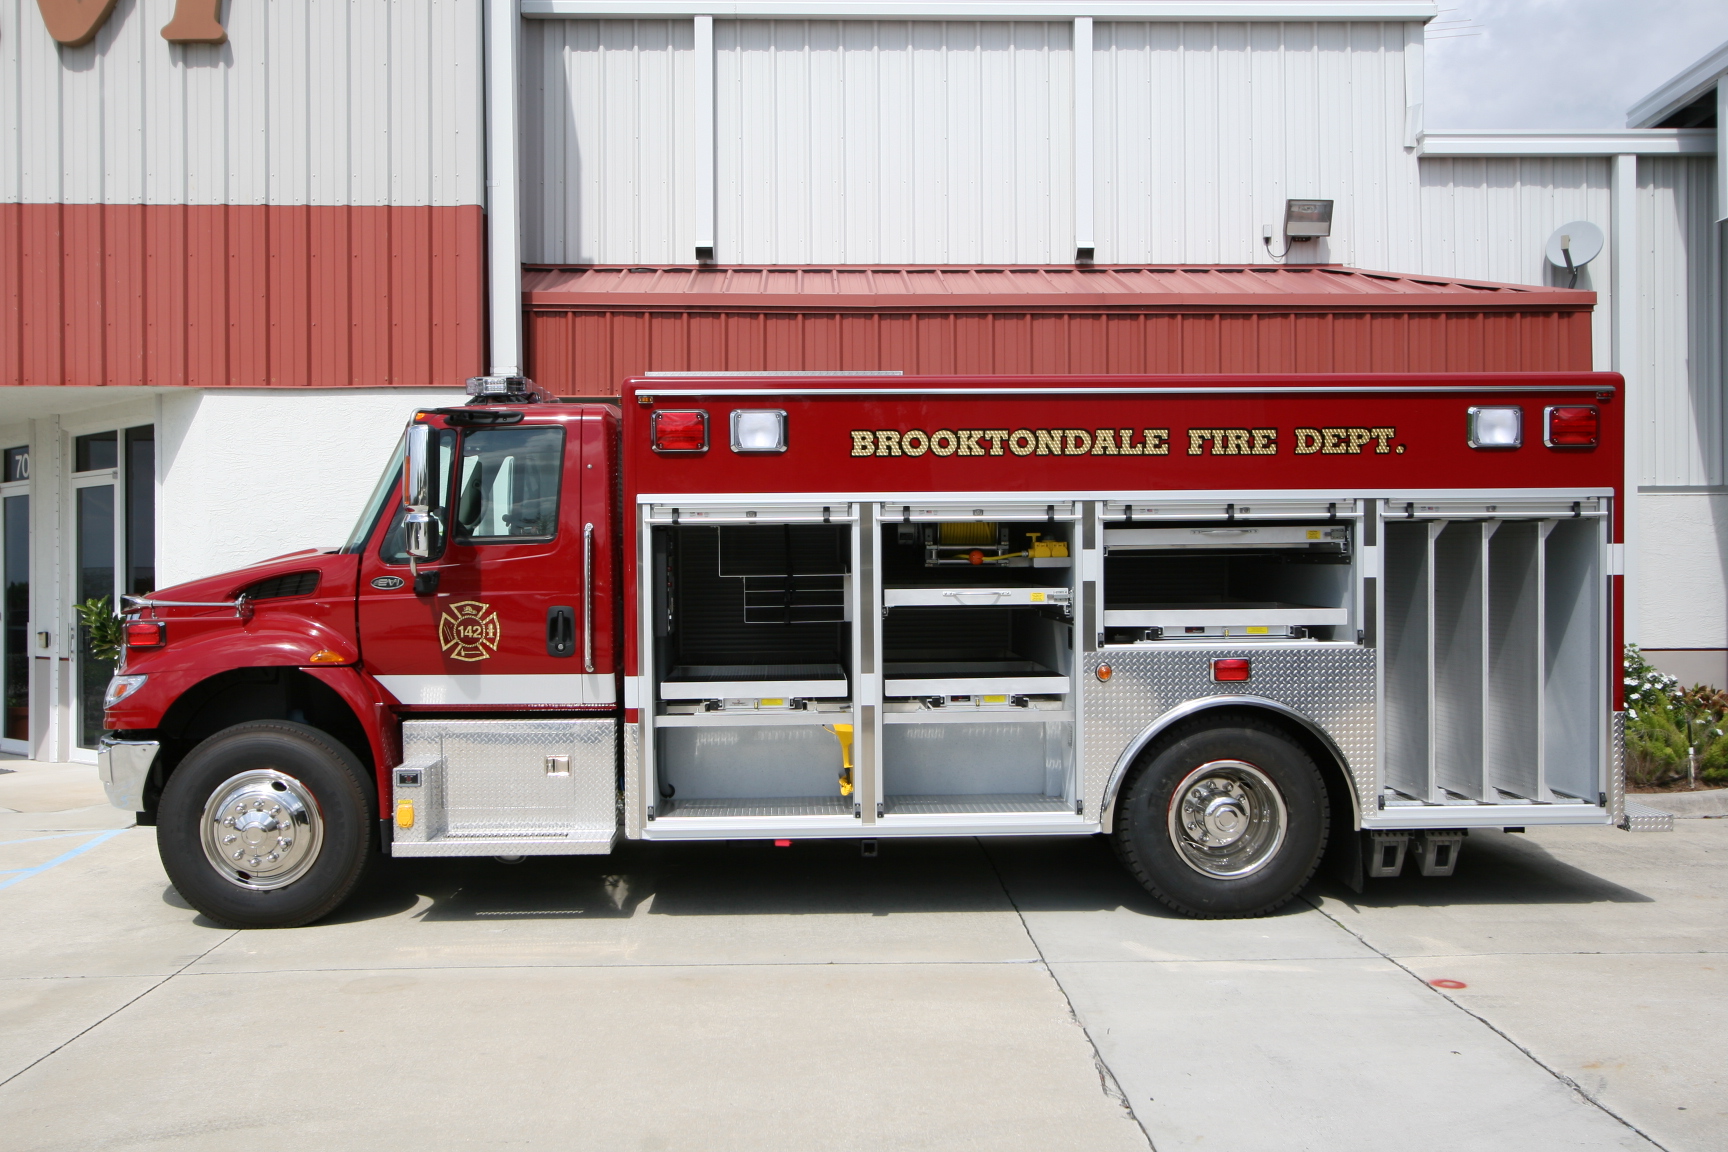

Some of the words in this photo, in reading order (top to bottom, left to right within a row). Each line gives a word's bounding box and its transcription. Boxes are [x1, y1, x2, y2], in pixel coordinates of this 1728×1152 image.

[850, 429, 1170, 457] BROOKTONDALE
[1186, 428, 1278, 456] FIRE
[1294, 427, 1408, 455] DEPT.
[15, 453, 30, 479] 70
[457, 625, 482, 638] 142
